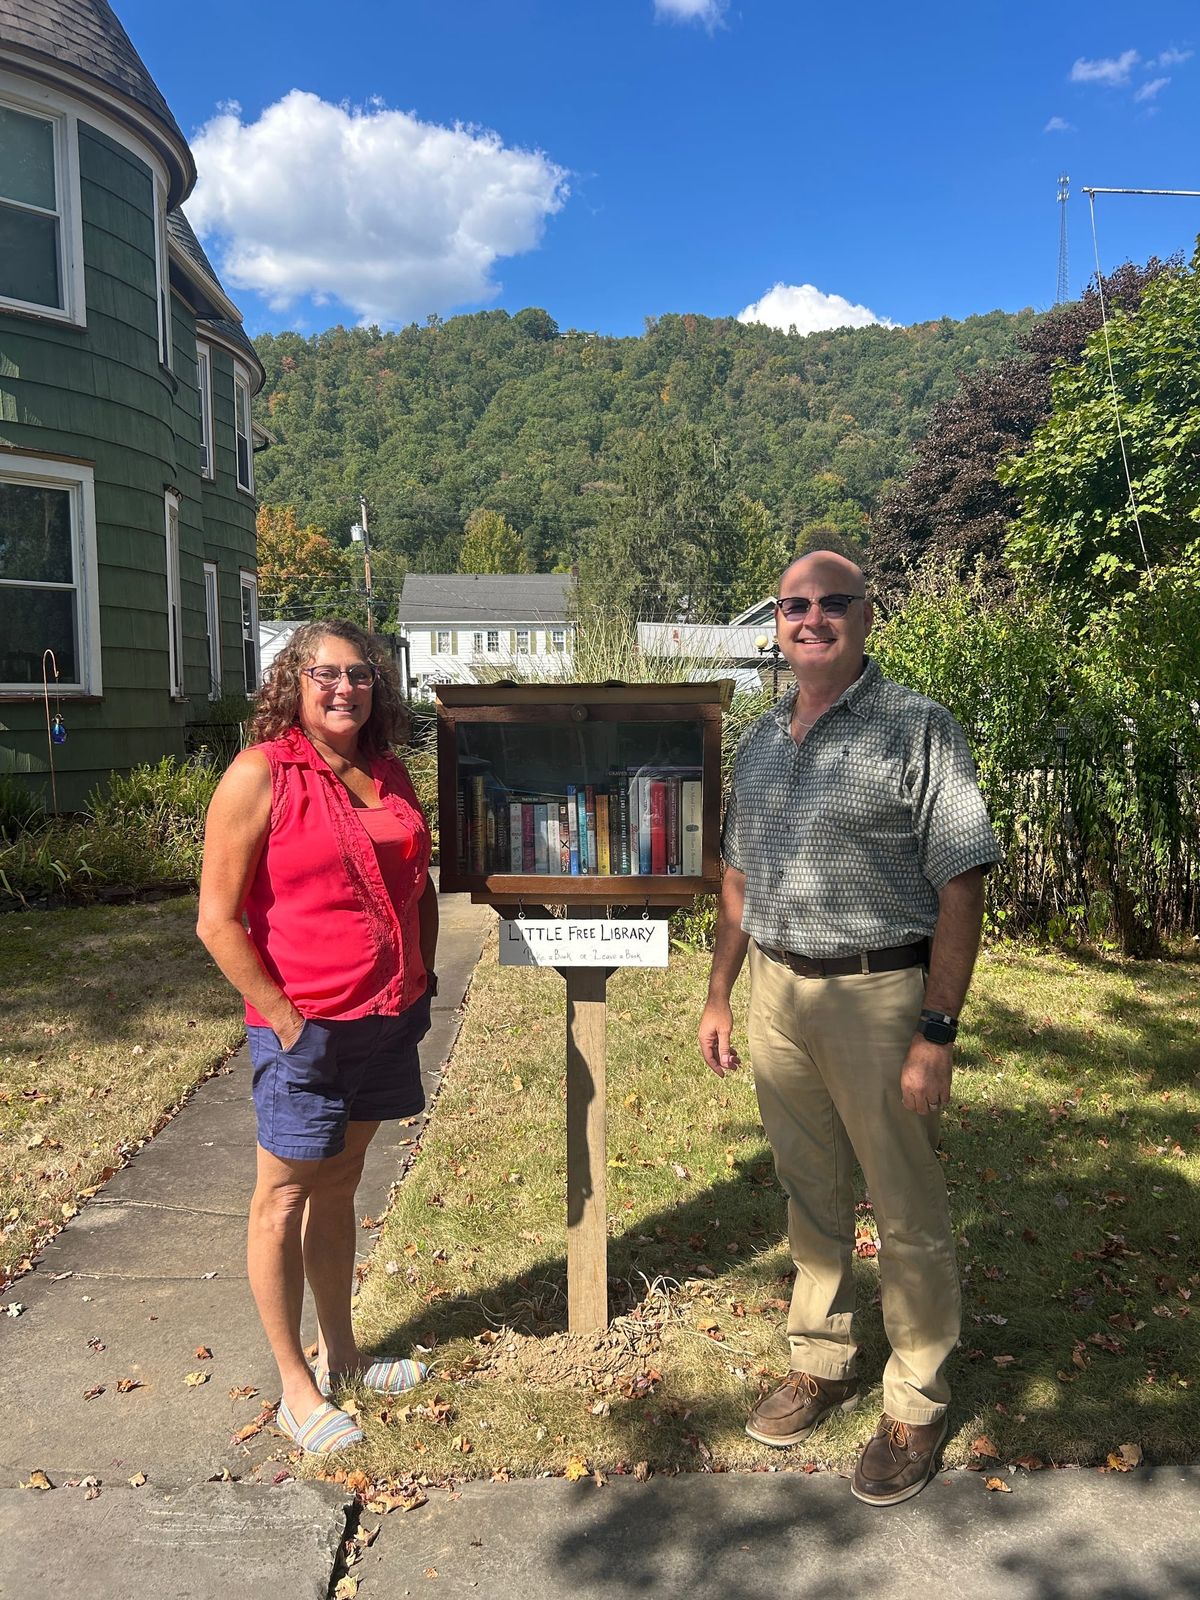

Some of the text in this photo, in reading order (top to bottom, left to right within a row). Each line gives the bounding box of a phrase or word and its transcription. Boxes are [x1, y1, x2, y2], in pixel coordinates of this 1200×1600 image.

[508, 923, 655, 943] LITTLE FREE LIBRARY
